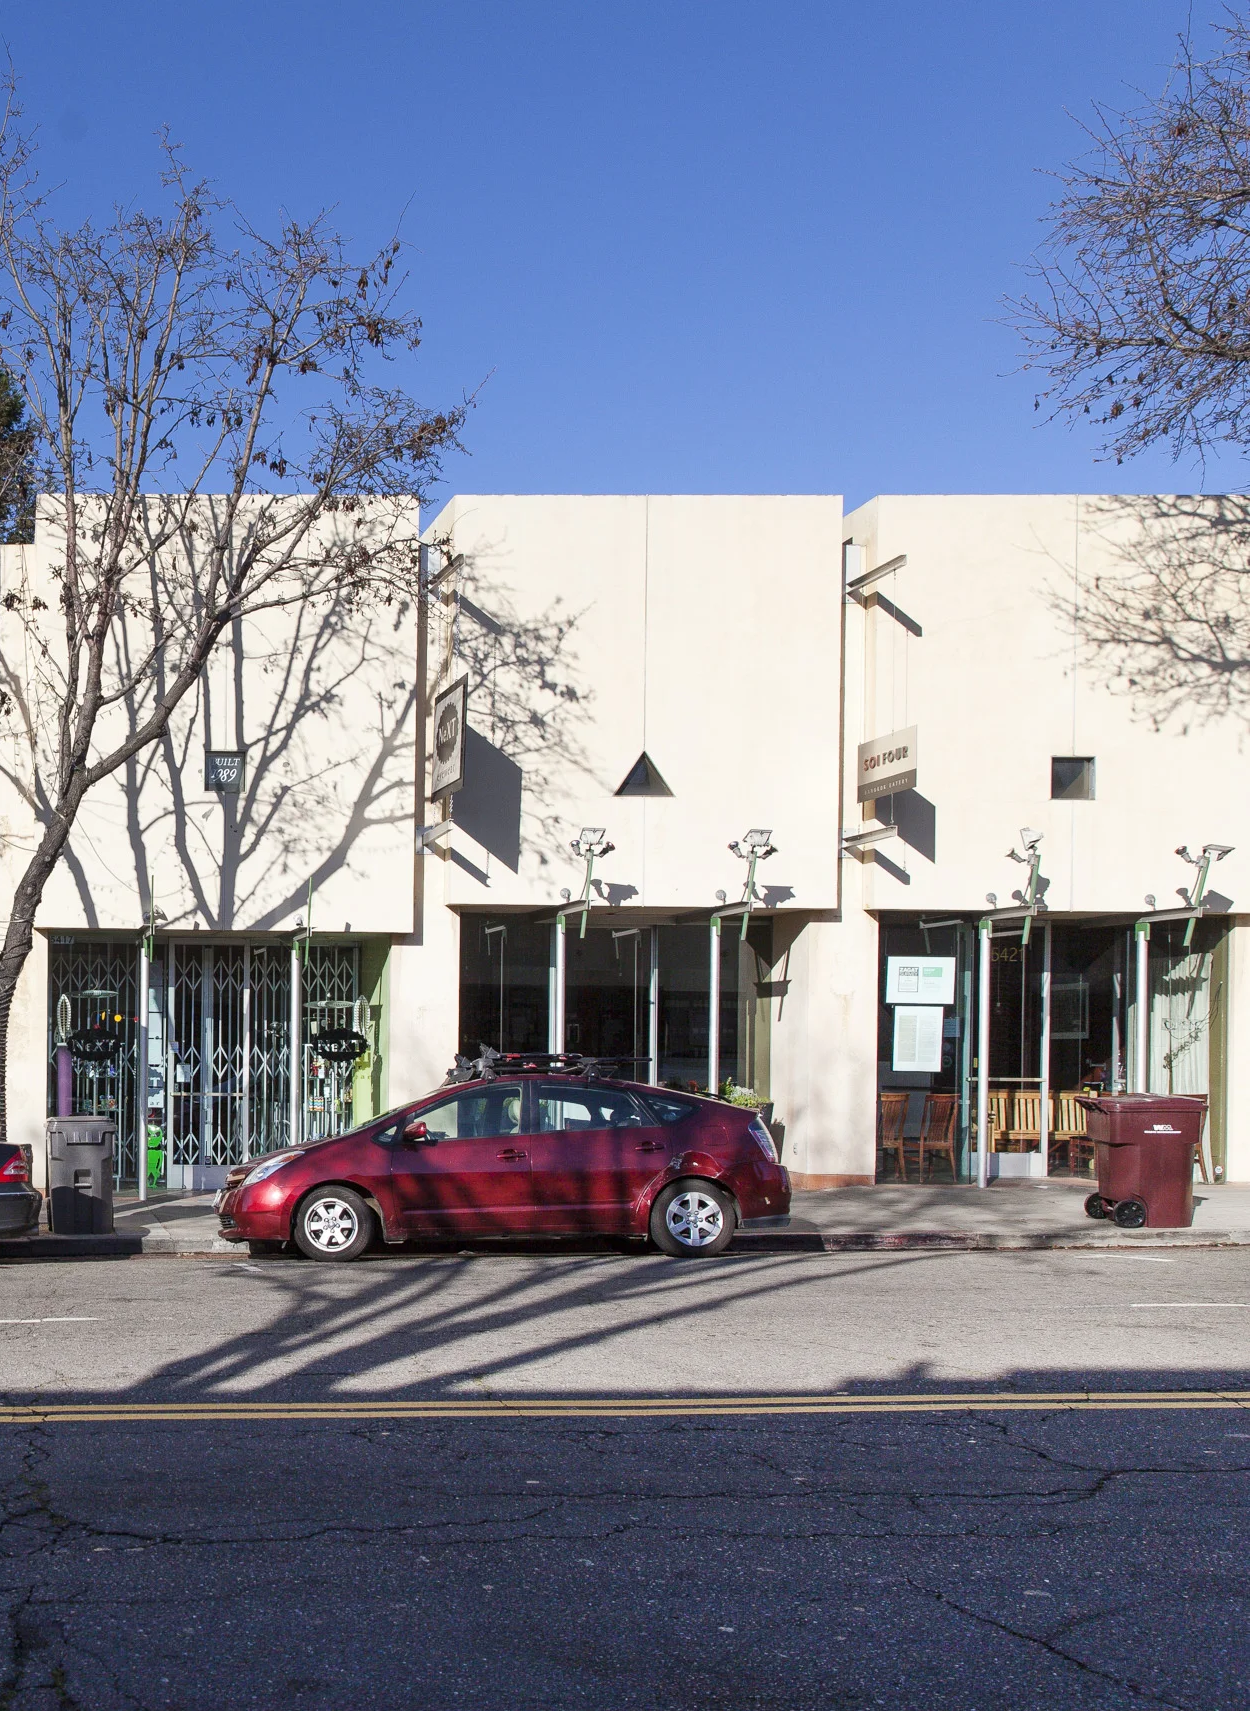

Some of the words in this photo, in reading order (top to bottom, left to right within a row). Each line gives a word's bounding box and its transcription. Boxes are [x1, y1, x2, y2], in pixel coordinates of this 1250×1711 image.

[438, 717, 456, 746] NeXT
[212, 757, 240, 766] BUILT
[863, 754, 880, 772] SOI
[882, 746, 909, 765] FOUR
[210, 768, 237, 782] 1989
[888, 778, 908, 788] EATERY
[50, 935, 74, 943] 5417
[991, 947, 1024, 962] 5421
[71, 1039, 116, 1052] NeXT
[317, 1039, 363, 1052] NeXT
